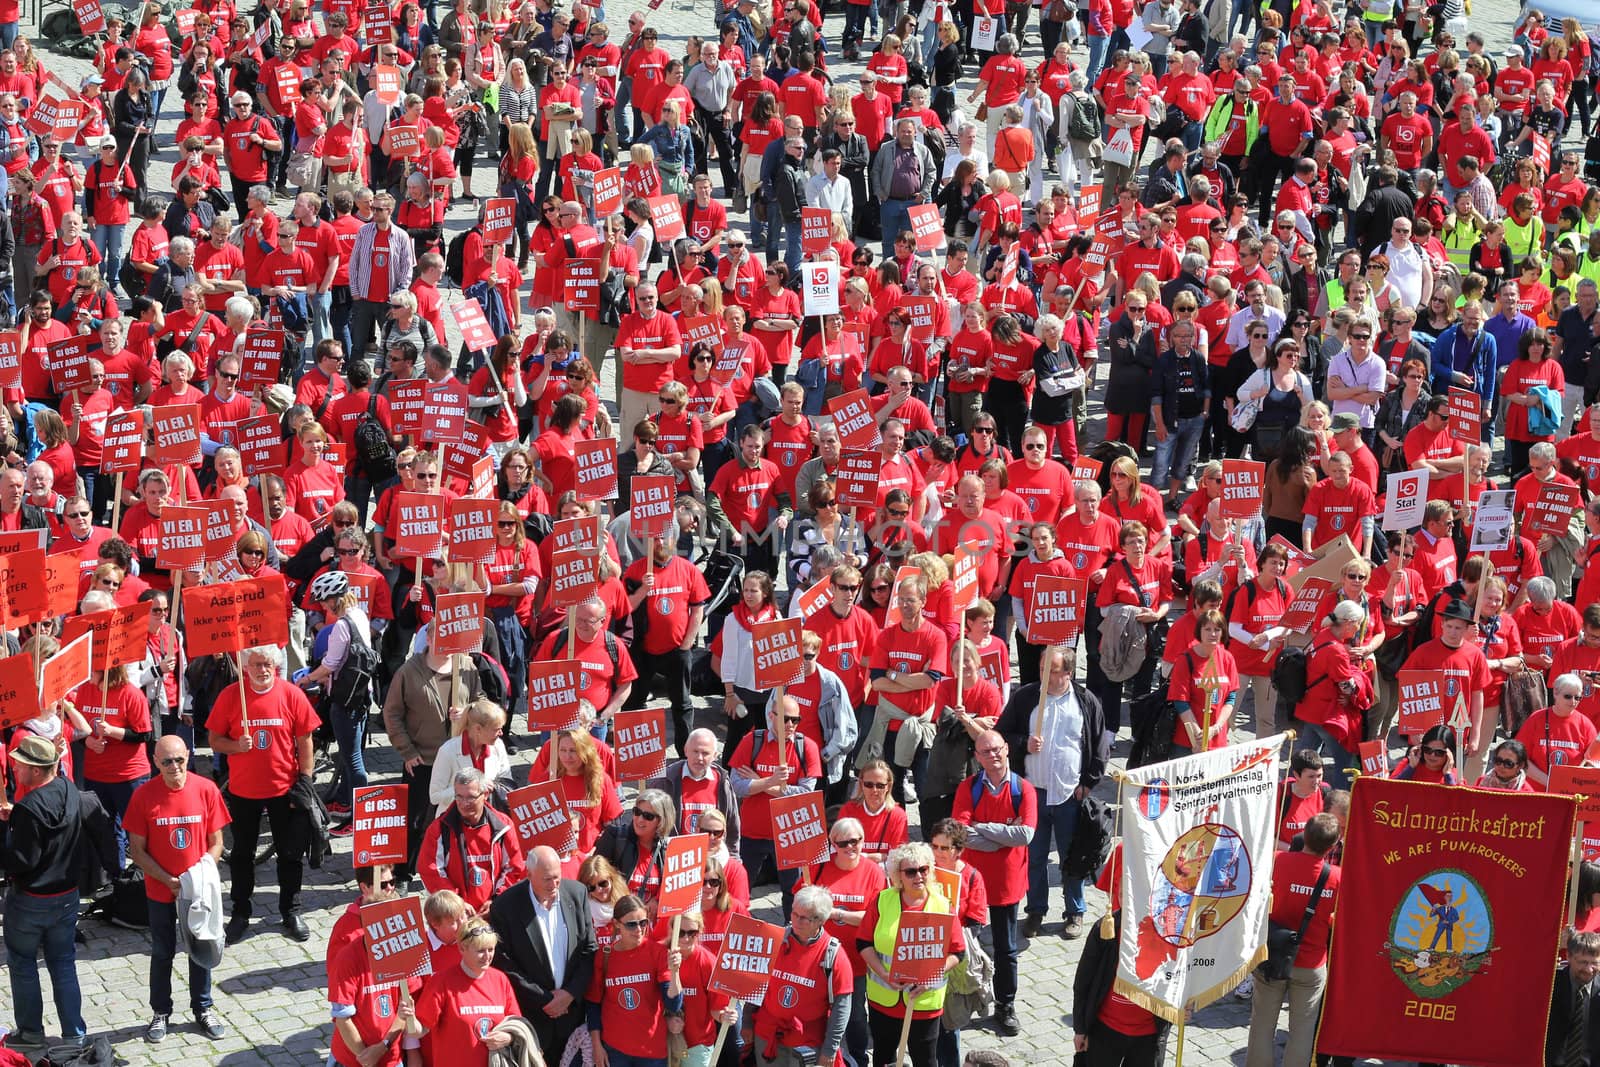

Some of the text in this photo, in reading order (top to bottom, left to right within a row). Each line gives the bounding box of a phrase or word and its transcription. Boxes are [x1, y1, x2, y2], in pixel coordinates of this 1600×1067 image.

[804, 218, 812, 227] VI
[813, 217, 822, 226] ER
[804, 228, 829, 239] STREIK
[813, 286, 829, 294] Stat
[253, 338, 275, 347] GI OSS
[257, 351, 280, 360] ANDRE
[254, 361, 266, 370] FÅR
[433, 393, 458, 403] GI OSS
[424, 406, 464, 416] DET ANDRE
[834, 399, 867, 422] VI ER I
[112, 422, 136, 432] GI OSS
[156, 414, 193, 432] VI ER I
[436, 418, 450, 428] FÅR
[839, 411, 874, 437] STREIK
[104, 434, 142, 447] DET ANDRE
[158, 428, 197, 447] STREIK
[115, 447, 128, 458] FÅR
[577, 448, 611, 467] VI ER I
[847, 459, 872, 468] GI OSS
[578, 462, 614, 483] STREIK
[838, 470, 878, 482] DET ANDRE
[1224, 472, 1258, 485] VI ER I
[634, 486, 669, 503] VI ER I
[850, 483, 864, 493] FÅR
[1224, 486, 1260, 500] STREIK
[1396, 498, 1416, 508] Stat
[1555, 493, 1570, 502] OSS
[401, 505, 437, 520] VI ER I
[634, 500, 671, 519] STREIK
[1536, 502, 1573, 514] DET ANDRE
[163, 518, 201, 534] VI ER I
[454, 510, 492, 527] VI ER I
[1544, 513, 1557, 522] FÅR
[400, 520, 439, 536] STREIK
[453, 525, 494, 543] STREIK
[162, 534, 203, 550] STREIK
[210, 588, 265, 608] Aaserud
[1037, 590, 1075, 606] VI ER I
[439, 603, 478, 622] VI ER I
[1035, 606, 1076, 623] STREIK
[439, 617, 480, 637] STREIK
[755, 629, 796, 653] VI ER I
[757, 644, 802, 670] STREIK
[532, 672, 574, 693] VI ER I
[1401, 681, 1438, 699] VI ER I
[532, 688, 577, 710] STREIK
[1402, 696, 1441, 715] STREIK
[617, 721, 659, 743] VI ER I
[618, 736, 663, 761] STREIK
[1176, 770, 1204, 785] Norsk
[1176, 771, 1262, 800] Tjenestemannslag
[365, 799, 396, 812] GI OSS
[513, 792, 559, 821] VI ER I
[356, 816, 405, 831] DET ANDRE
[519, 808, 567, 839] STREIK
[775, 803, 818, 830] VI ER I
[371, 832, 388, 846] FÅR
[778, 819, 824, 848] STREIK
[668, 847, 702, 872] VI ER I
[1384, 840, 1527, 878] WE ARE PUNKROCKERS
[665, 866, 701, 892] STREIK
[366, 910, 416, 940] VI ER I
[901, 926, 944, 942] VI ER I
[371, 928, 424, 960] STREIK
[729, 933, 773, 954] VI ER I
[898, 943, 944, 961] STREIK
[721, 952, 770, 974] STREIK
[1405, 1001, 1456, 1021] 2008
